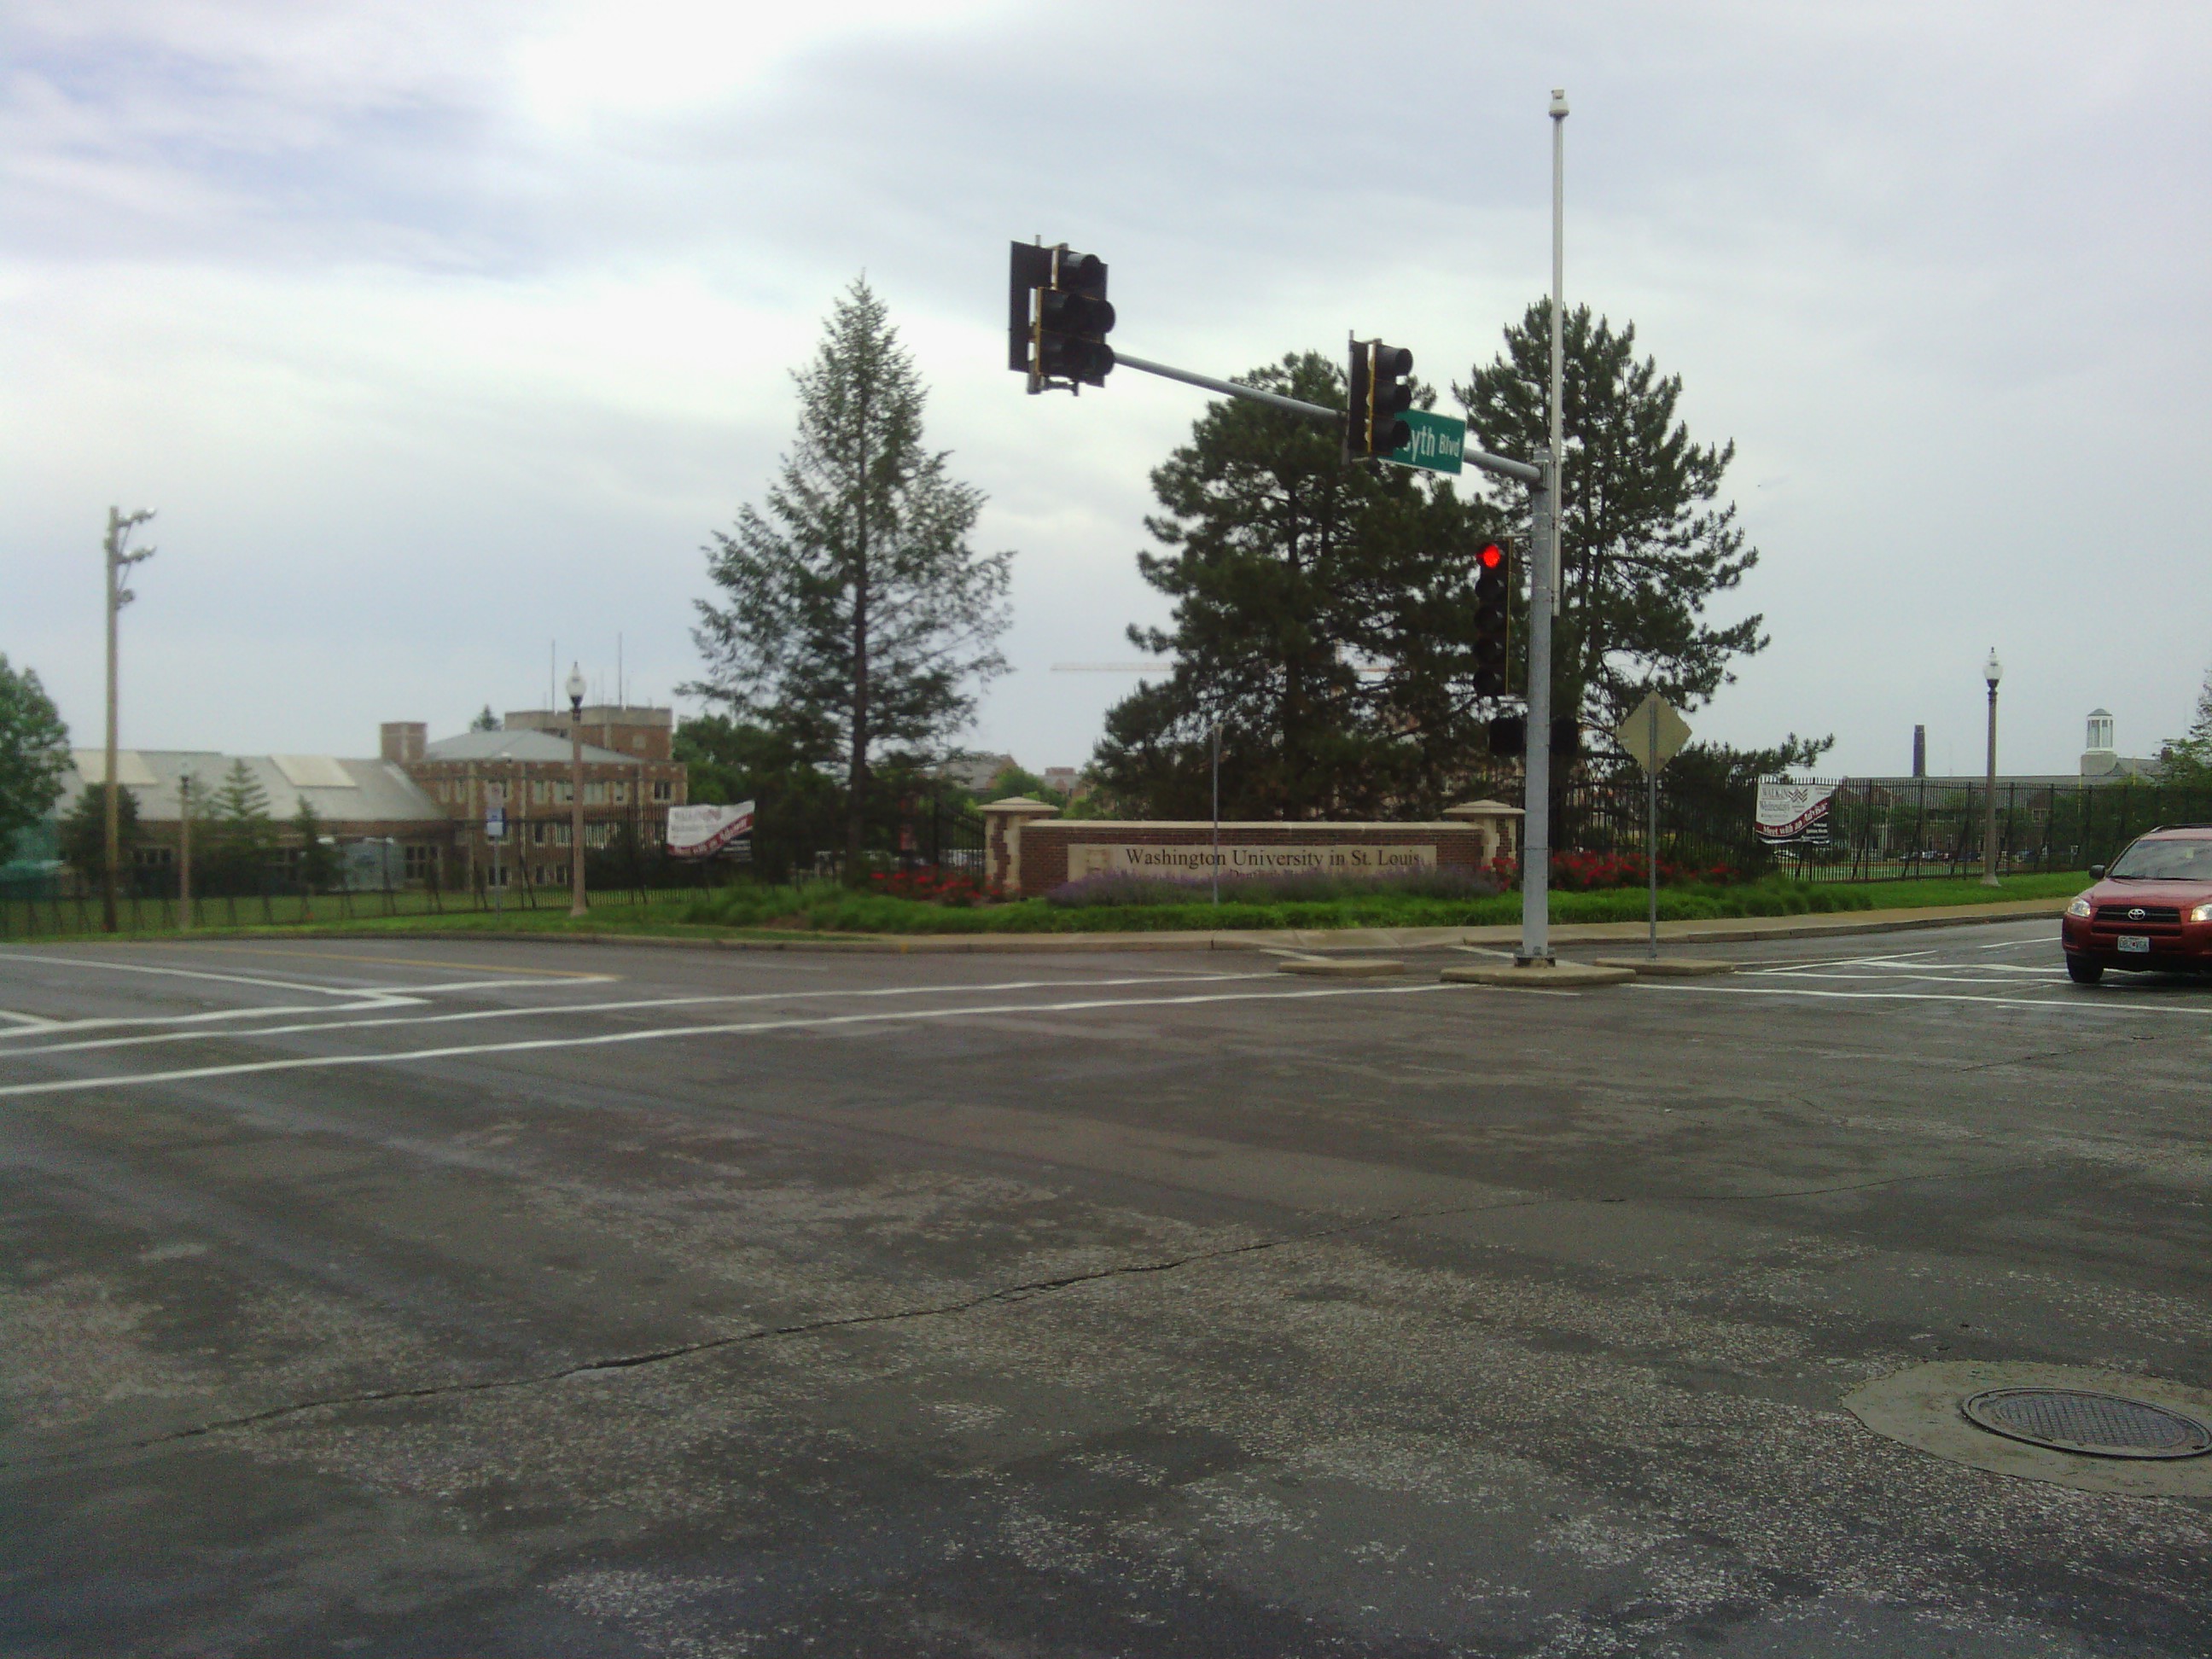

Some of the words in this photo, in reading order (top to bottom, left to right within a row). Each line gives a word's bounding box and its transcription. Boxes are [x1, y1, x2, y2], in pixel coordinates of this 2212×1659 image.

[1439, 433, 1460, 457] Blvd
[1126, 848, 1226, 870] Washington
[1232, 849, 1322, 867] University
[1330, 849, 1345, 865] in
[1352, 849, 1371, 865] St.
[1378, 849, 1420, 865] Louis
